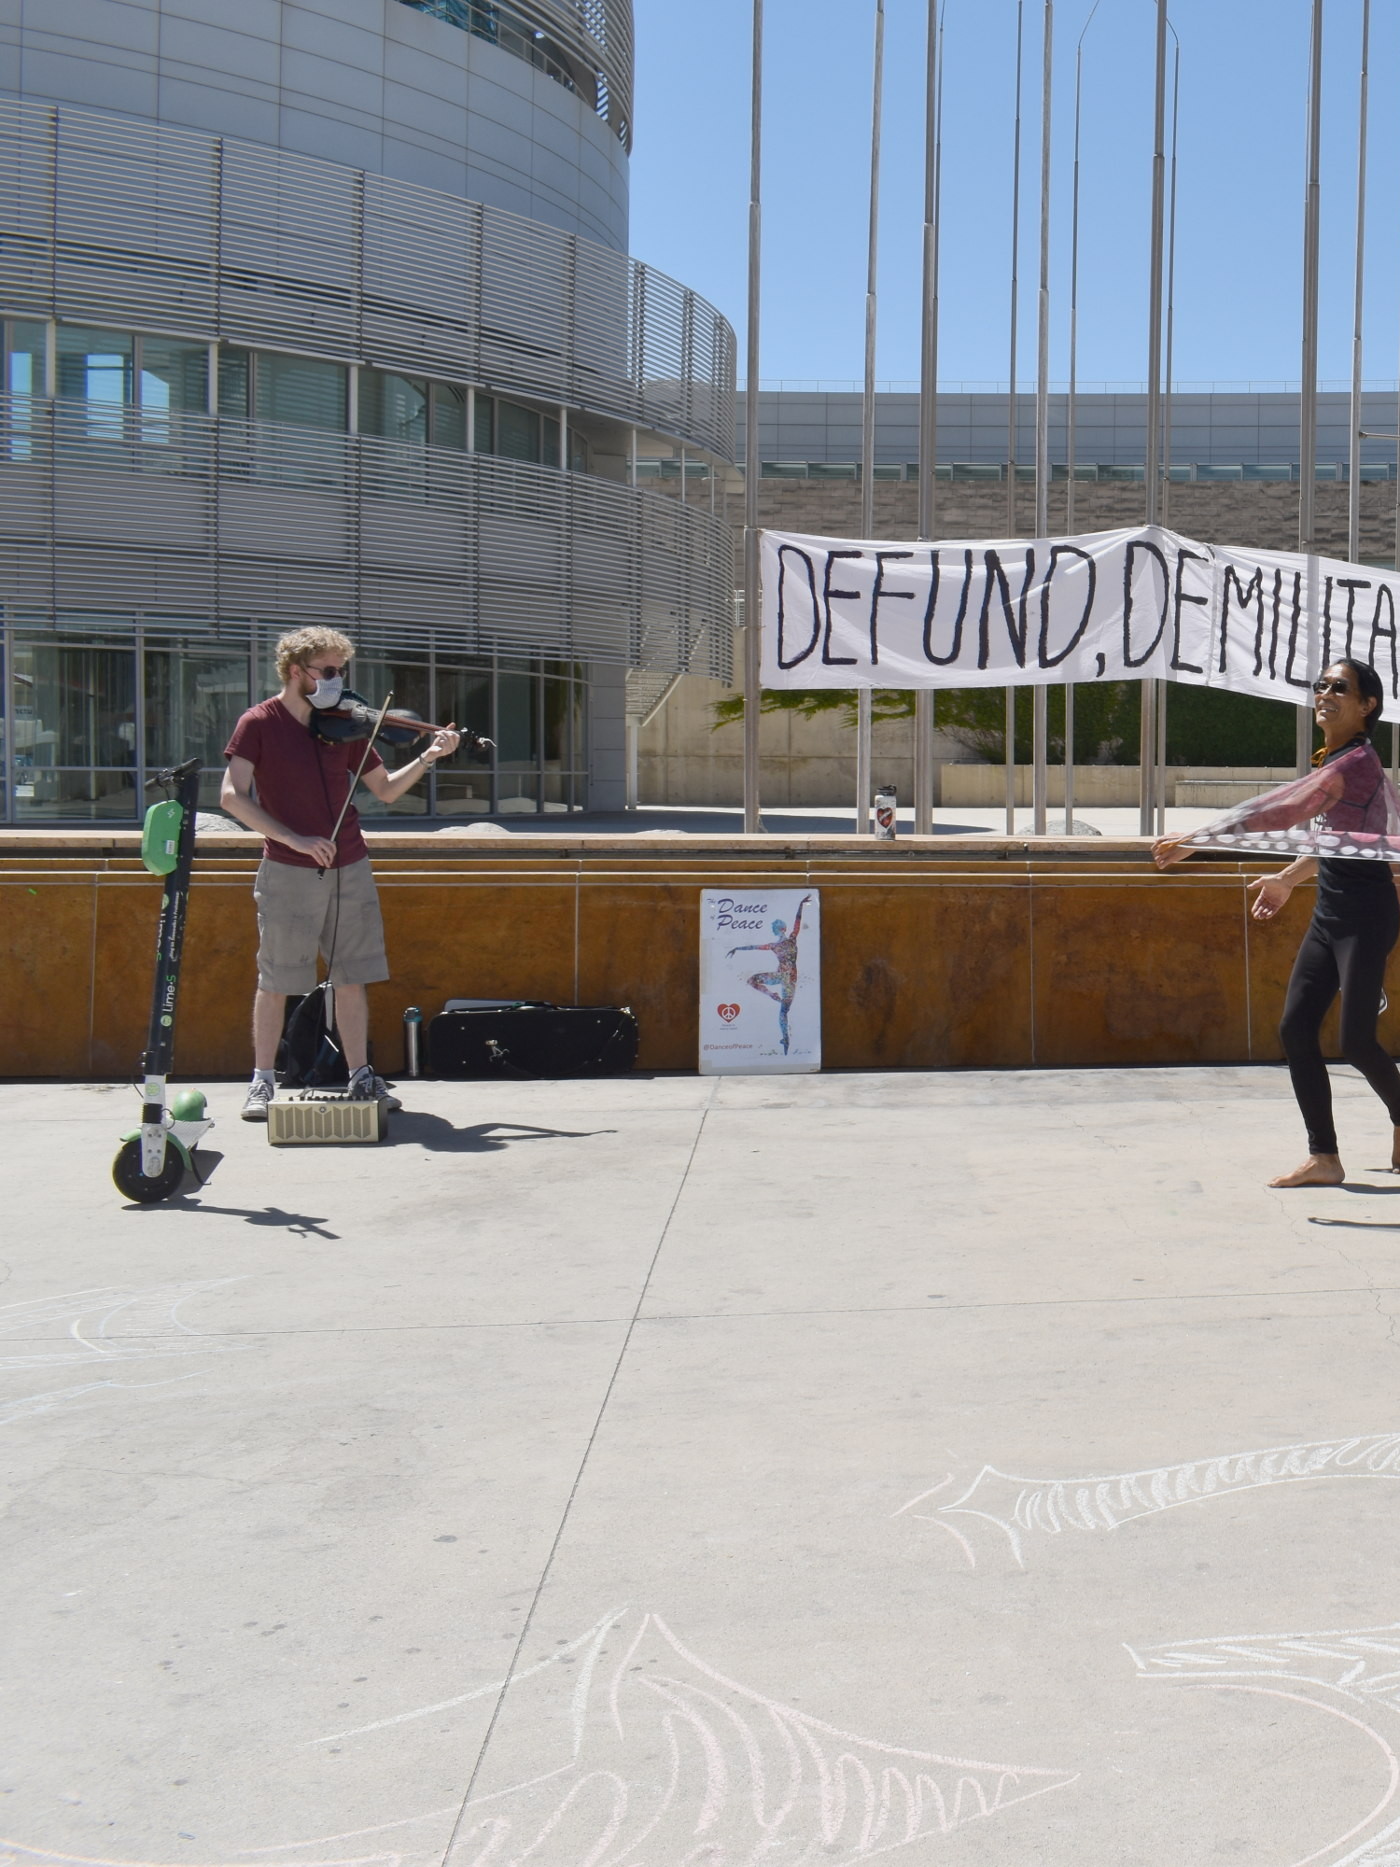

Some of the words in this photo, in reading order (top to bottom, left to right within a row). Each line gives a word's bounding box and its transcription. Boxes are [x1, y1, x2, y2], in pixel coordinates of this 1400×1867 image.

[777, 543, 1106, 678] DEFUND,
[717, 898, 768, 914] Dance
[716, 914, 764, 931] Peace
